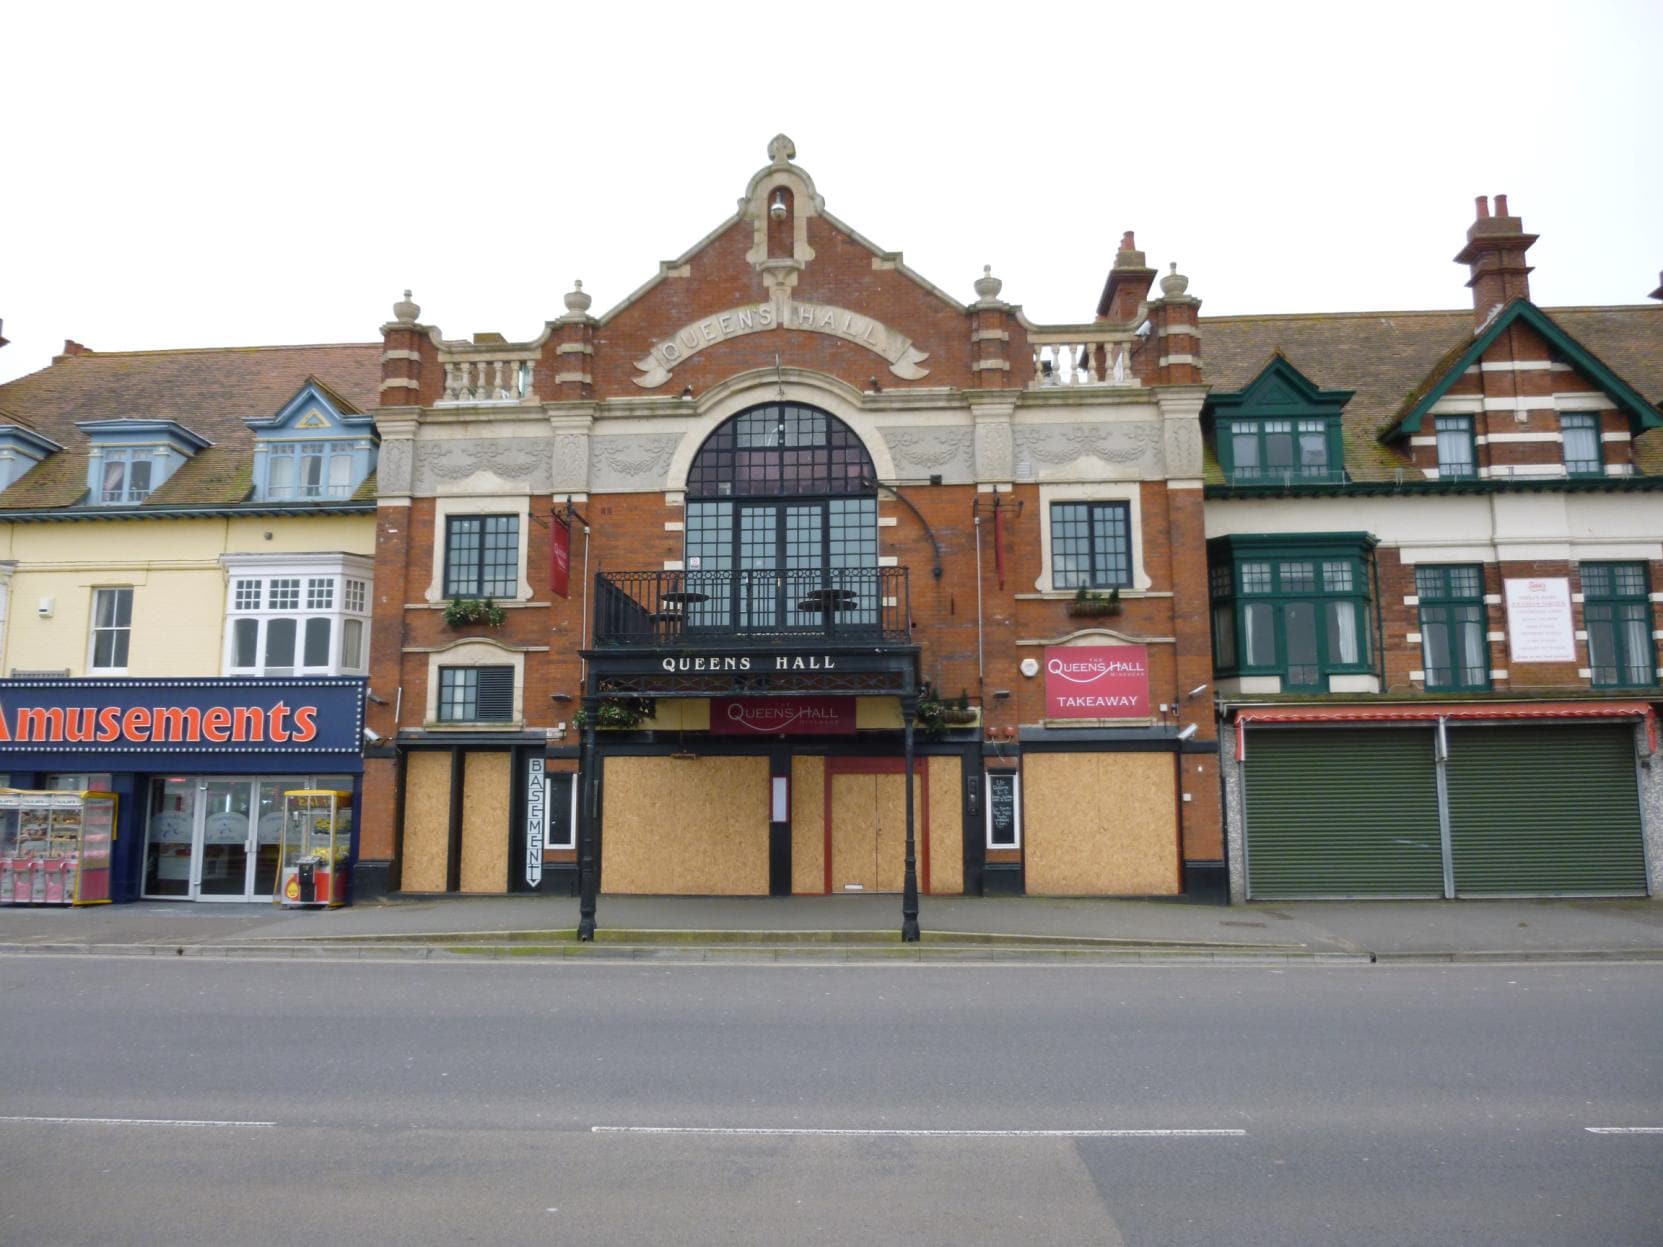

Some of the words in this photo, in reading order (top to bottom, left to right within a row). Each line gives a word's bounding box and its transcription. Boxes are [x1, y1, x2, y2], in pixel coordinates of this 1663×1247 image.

[662, 657, 751, 671] QUEENS
[775, 656, 836, 669] HALL
[1048, 659, 1105, 676] QUEENS
[1110, 661, 1144, 672] HALL
[1056, 696, 1138, 707] TAKEAWAY
[728, 703, 794, 723] QUEENS
[800, 706, 839, 718] HALL
[528, 760, 543, 881] BASEMENT
